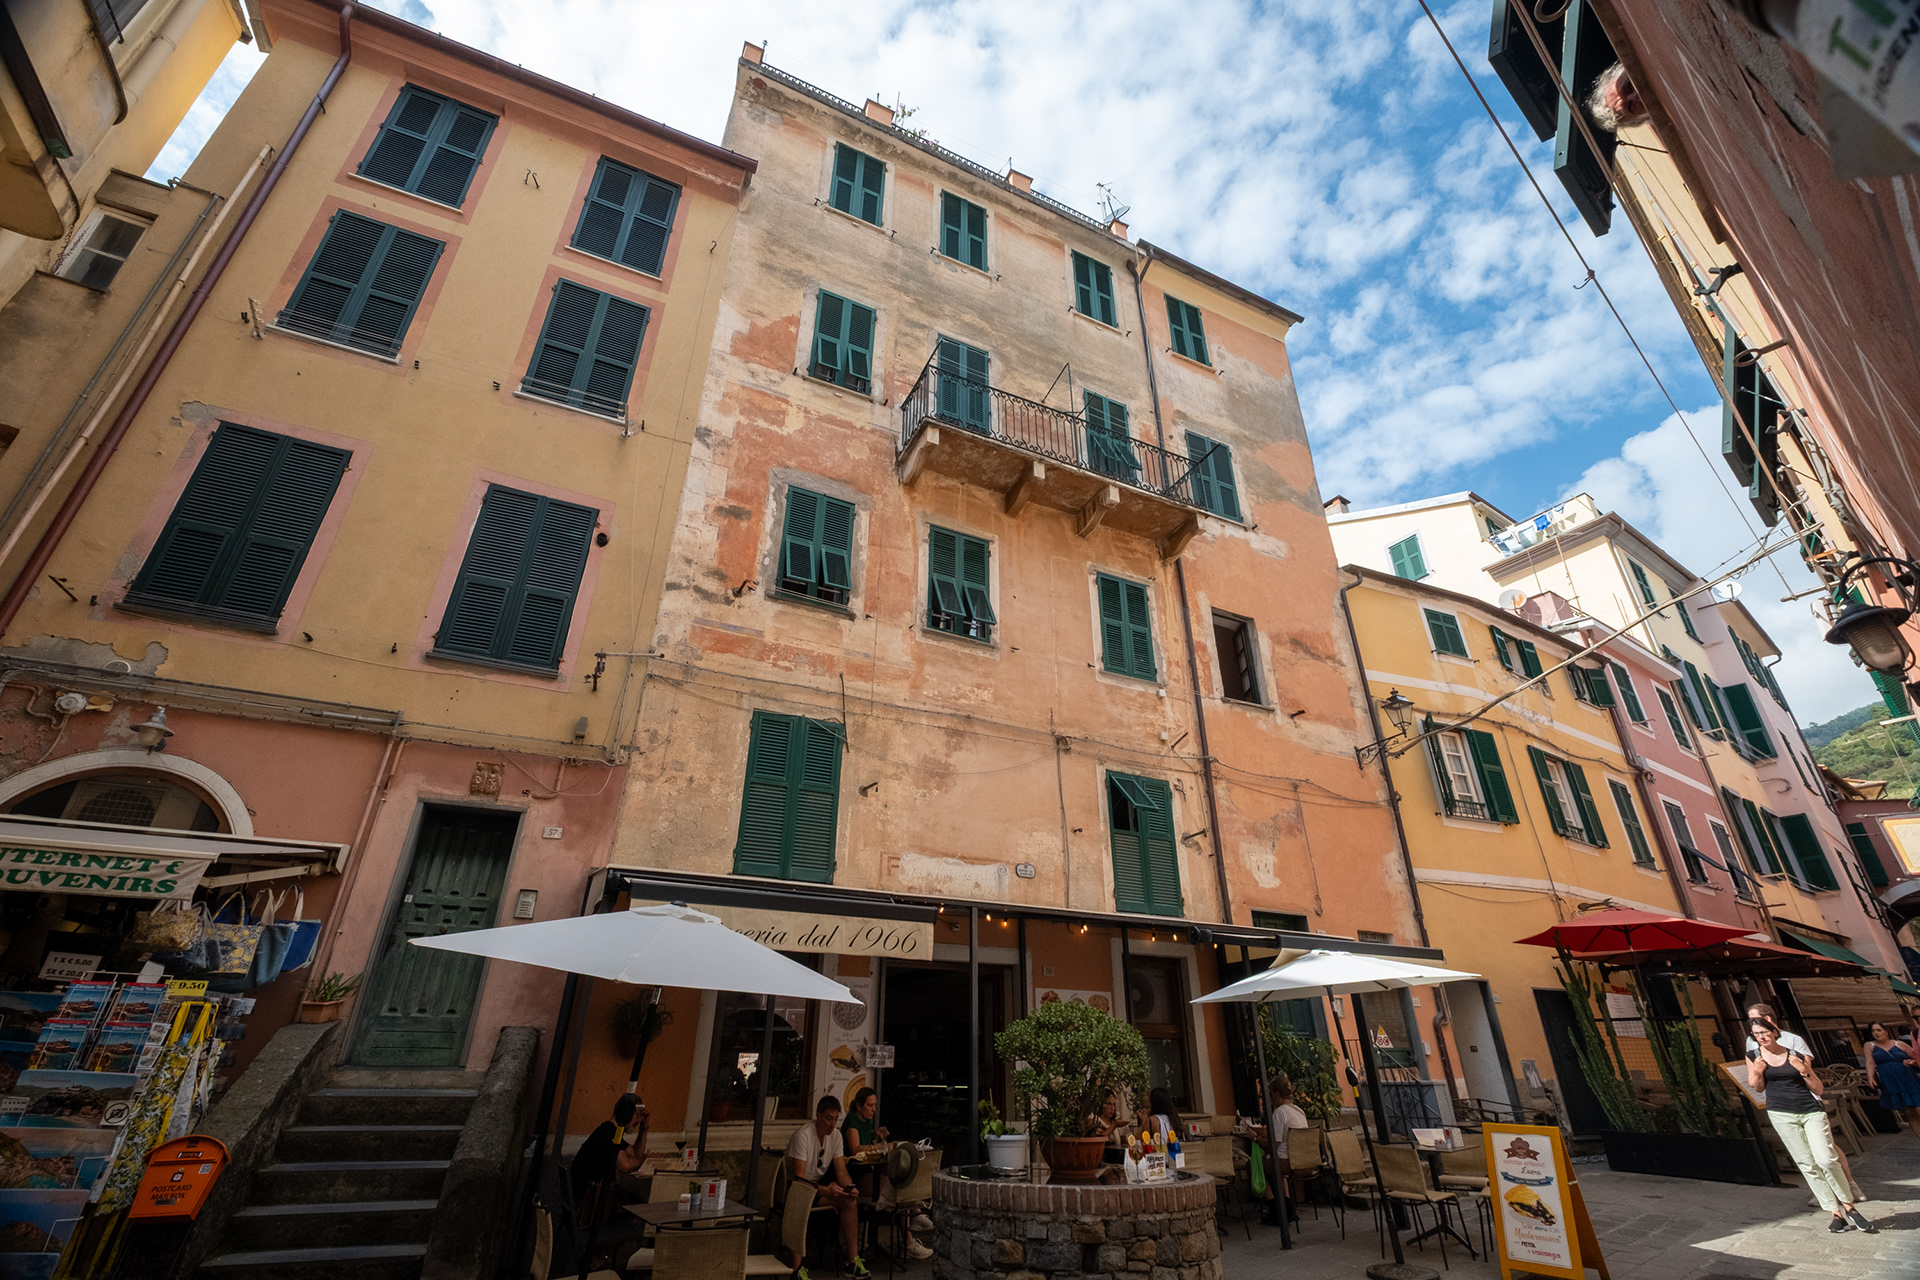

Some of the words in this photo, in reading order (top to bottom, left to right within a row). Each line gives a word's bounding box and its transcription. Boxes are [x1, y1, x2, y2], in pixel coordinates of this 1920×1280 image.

[547, 828, 559, 837] 57
[0, 868, 178, 894] UVENIRS
[797, 924, 840, 948] dal
[847, 925, 922, 954] 1966
[74, 958, 93, 966] 5.00
[178, 981, 205, 990] 9.50
